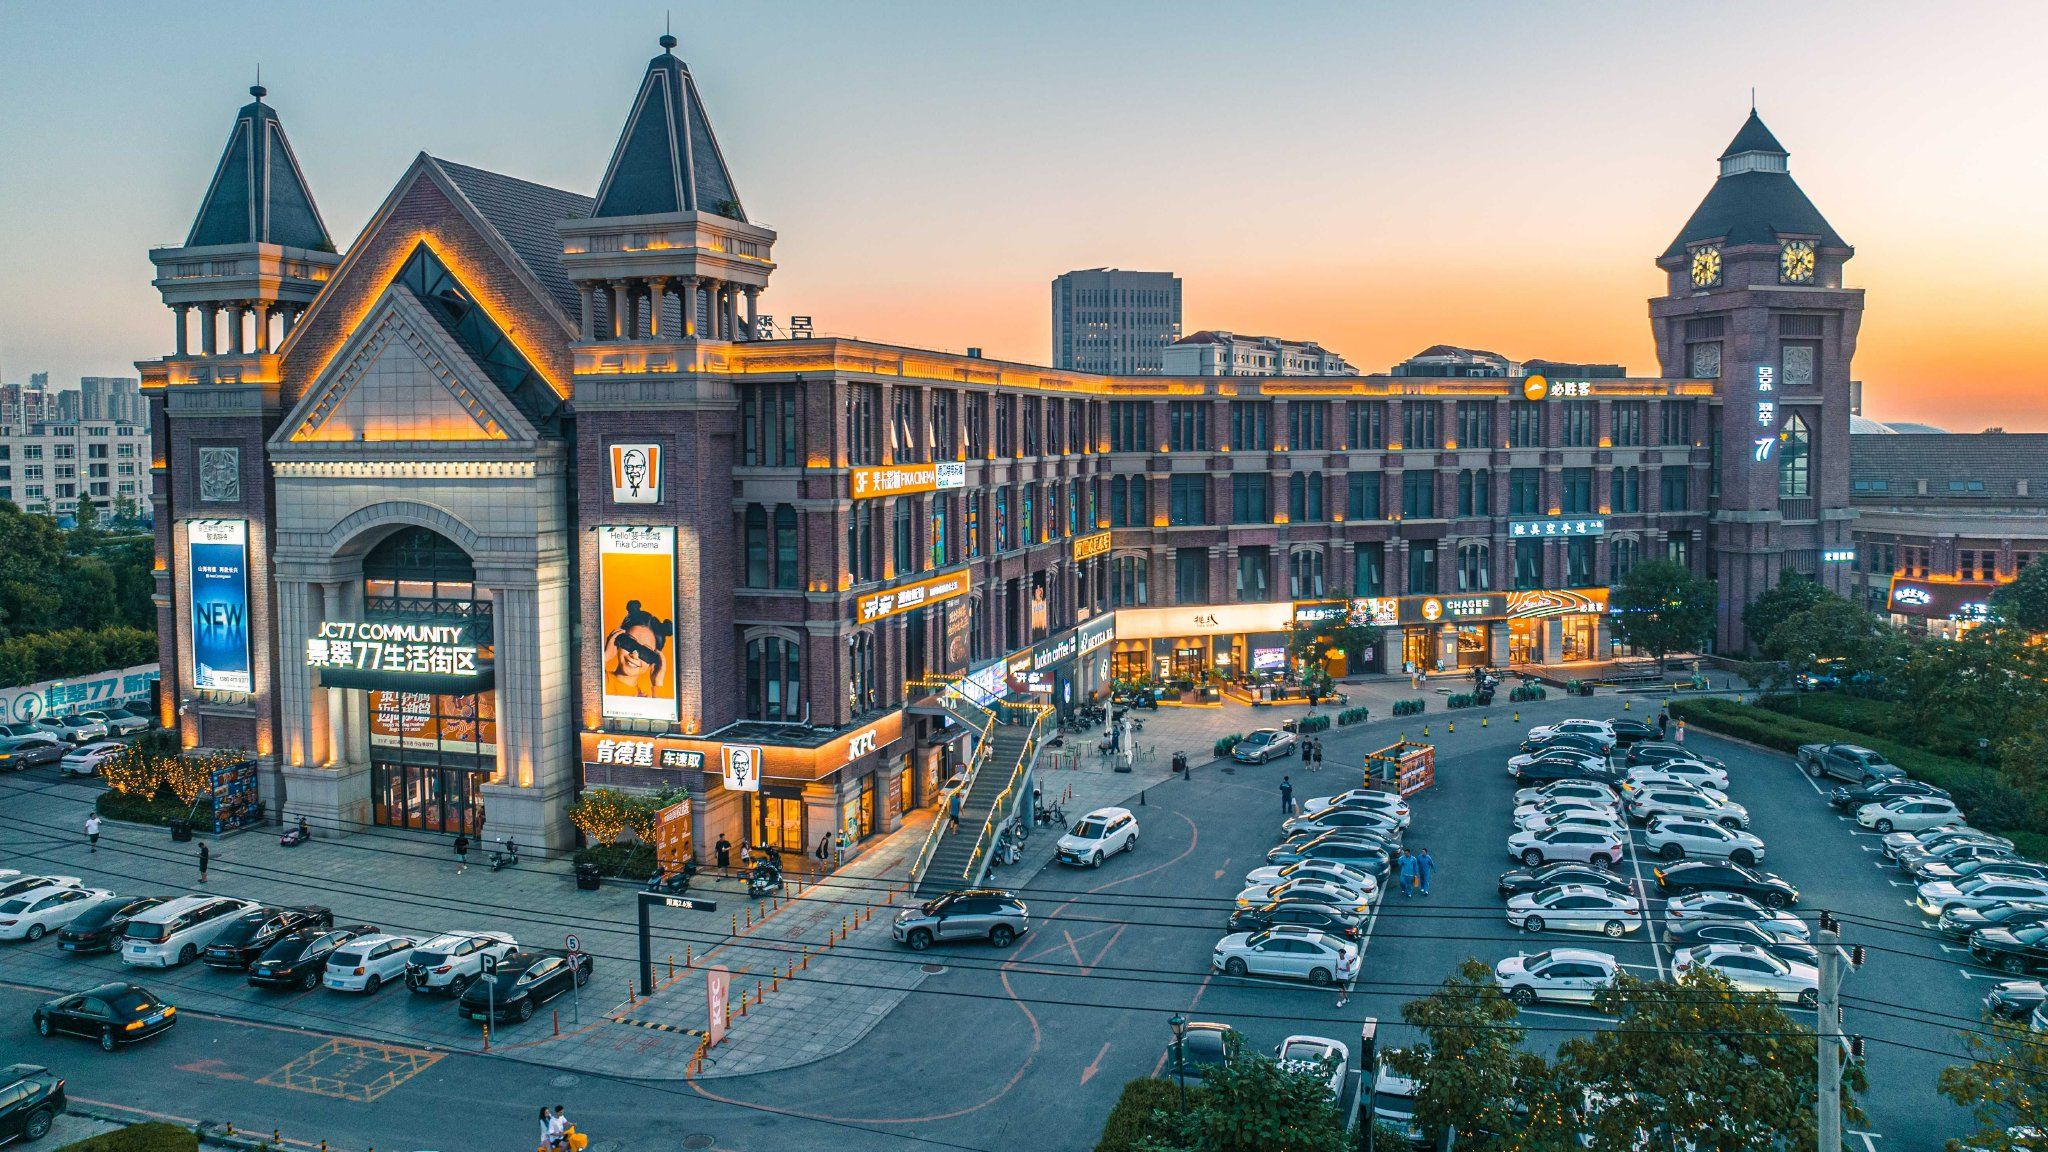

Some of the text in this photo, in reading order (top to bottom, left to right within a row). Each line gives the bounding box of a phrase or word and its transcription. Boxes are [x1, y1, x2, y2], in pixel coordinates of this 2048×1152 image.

[1550, 381, 1591, 397] 必胜客
[1755, 366, 1775, 462] 景翠77
[855, 471, 869, 493] 3F
[615, 540, 659, 549] Fika Cinema
[197, 602, 243, 626] NEW
[1447, 599, 1490, 609] CHAGEE
[318, 621, 463, 644] JC77 COMMUNITY
[306, 638, 478, 676] 景翠77生活街区
[1035, 648, 1052, 671] luckin
[1053, 641, 1068, 662] coffee
[597, 740, 701, 768] 肯德基 车速取
[848, 729, 877, 761] KFC
[666, 898, 693, 909] 限高2.6米
[483, 955, 494, 972] P
[712, 977, 722, 1028] KFC
